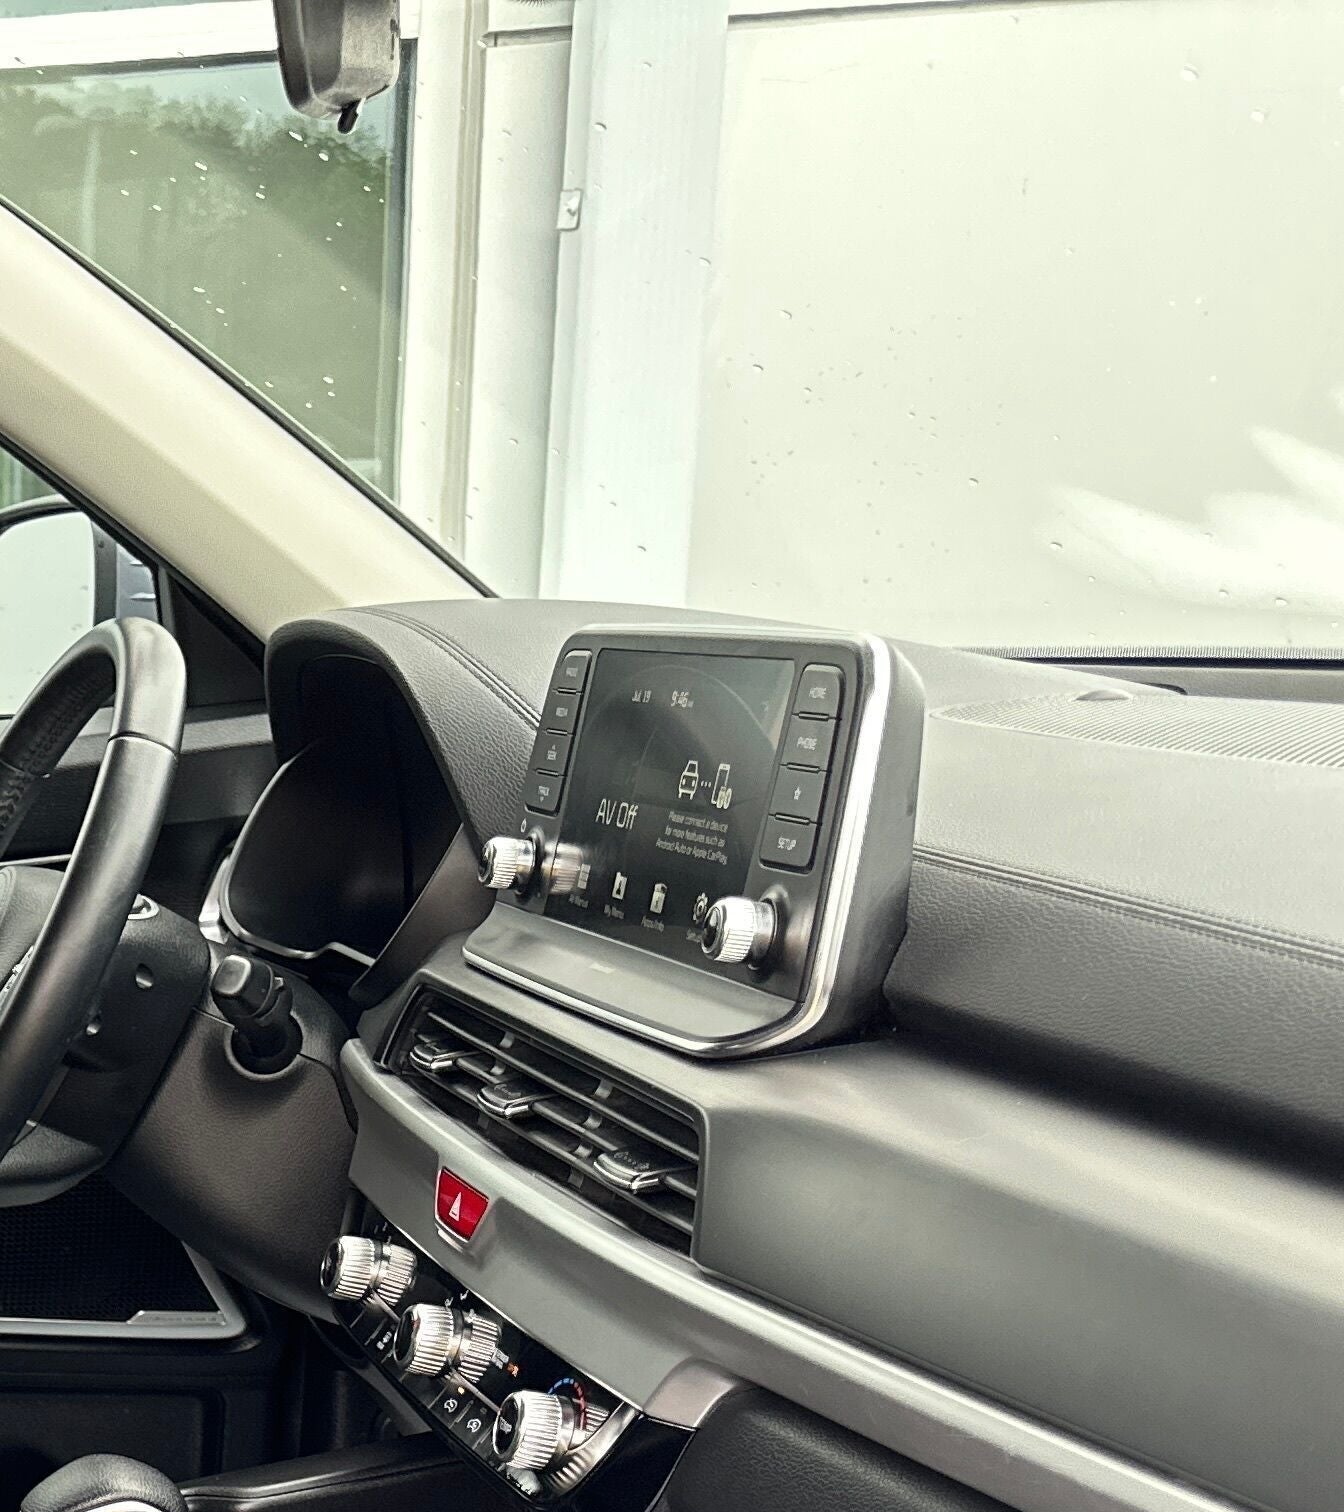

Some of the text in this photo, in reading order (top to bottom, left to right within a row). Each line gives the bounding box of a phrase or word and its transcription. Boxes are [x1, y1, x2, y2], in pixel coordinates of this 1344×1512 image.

[797, 736, 818, 751] PHONE
[595, 798, 639, 831] AV Off
[777, 836, 797, 851] SETUP
